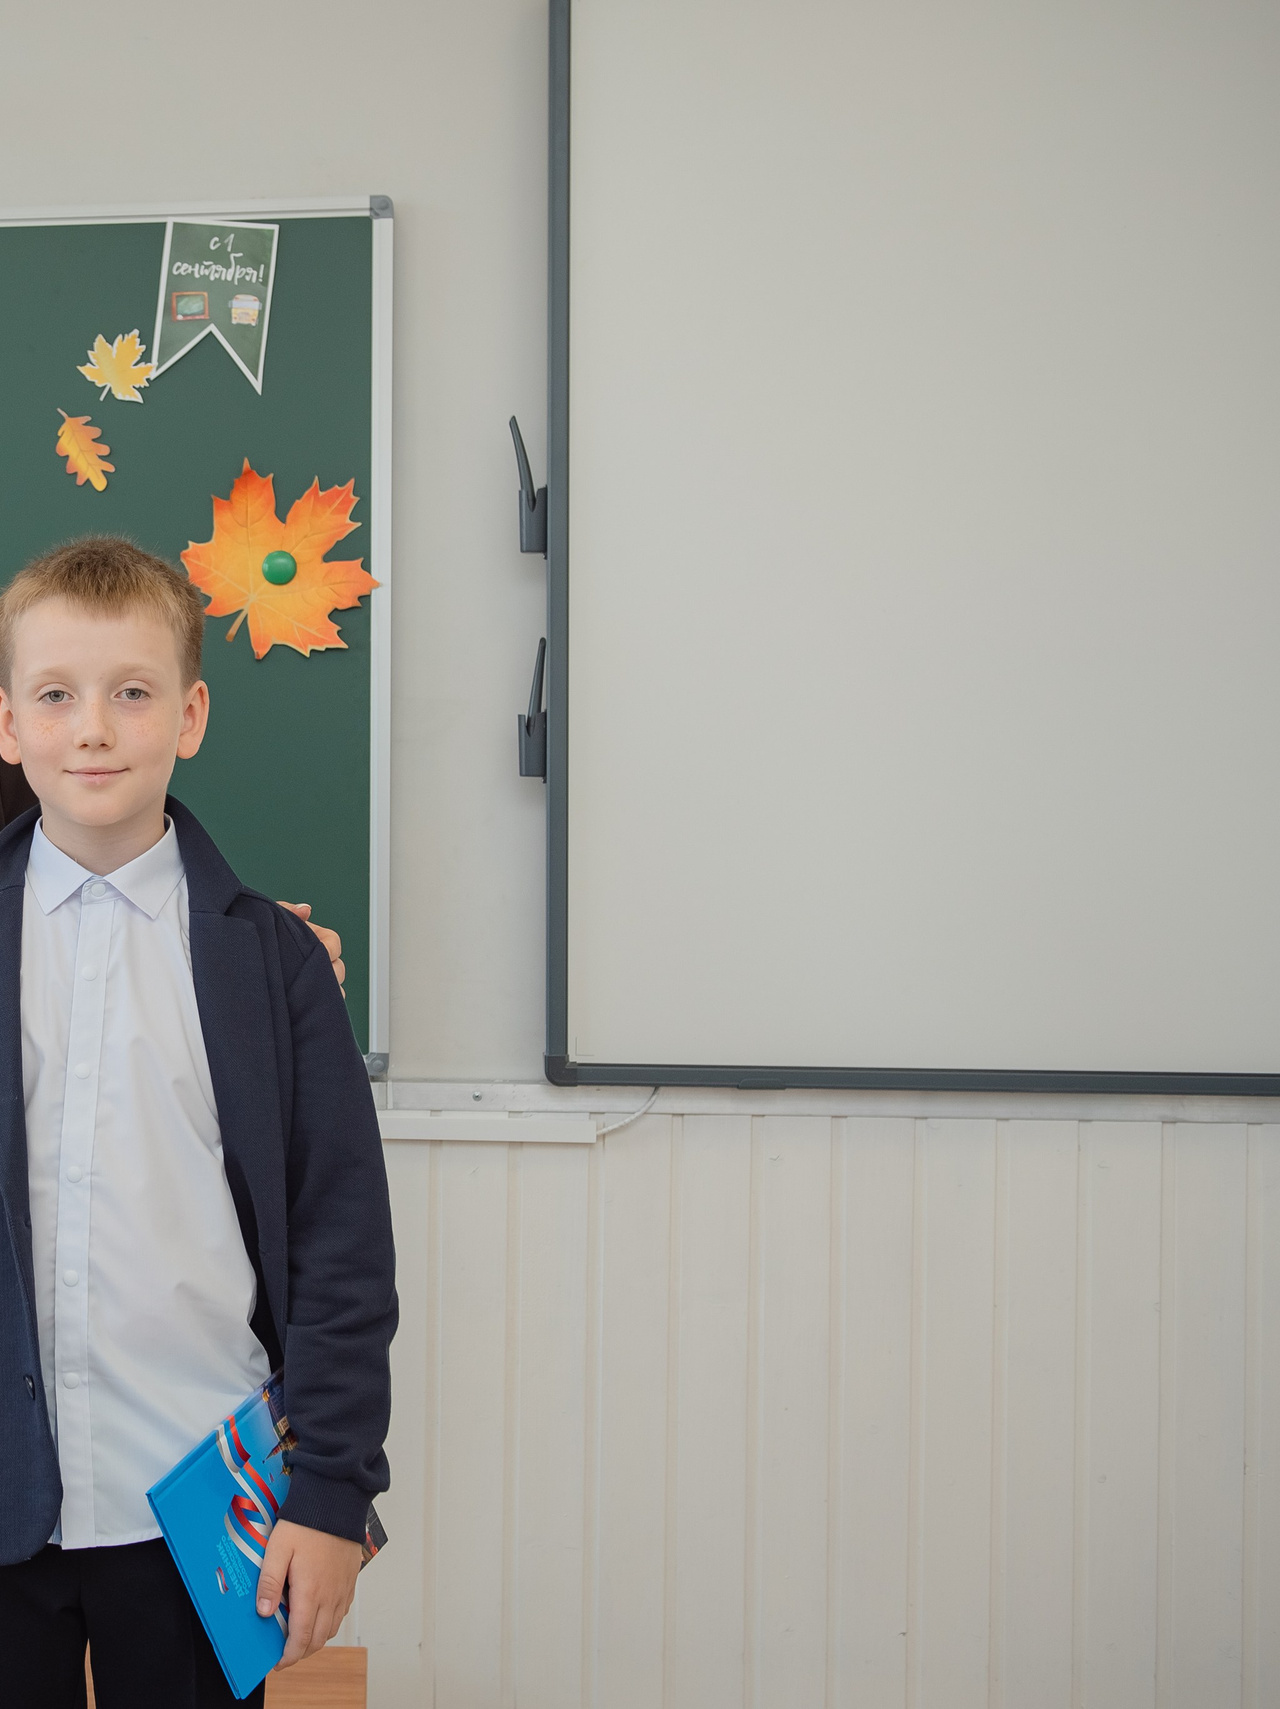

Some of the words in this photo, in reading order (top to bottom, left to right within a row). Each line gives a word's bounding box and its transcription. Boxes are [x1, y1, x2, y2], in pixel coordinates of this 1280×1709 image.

[224, 233, 235, 252] 1
[172, 252, 265, 286] сентября!
[216, 1540, 245, 1597] ДНЕВНИК
[221, 1535, 250, 1595] РОССИЙСКОГО
